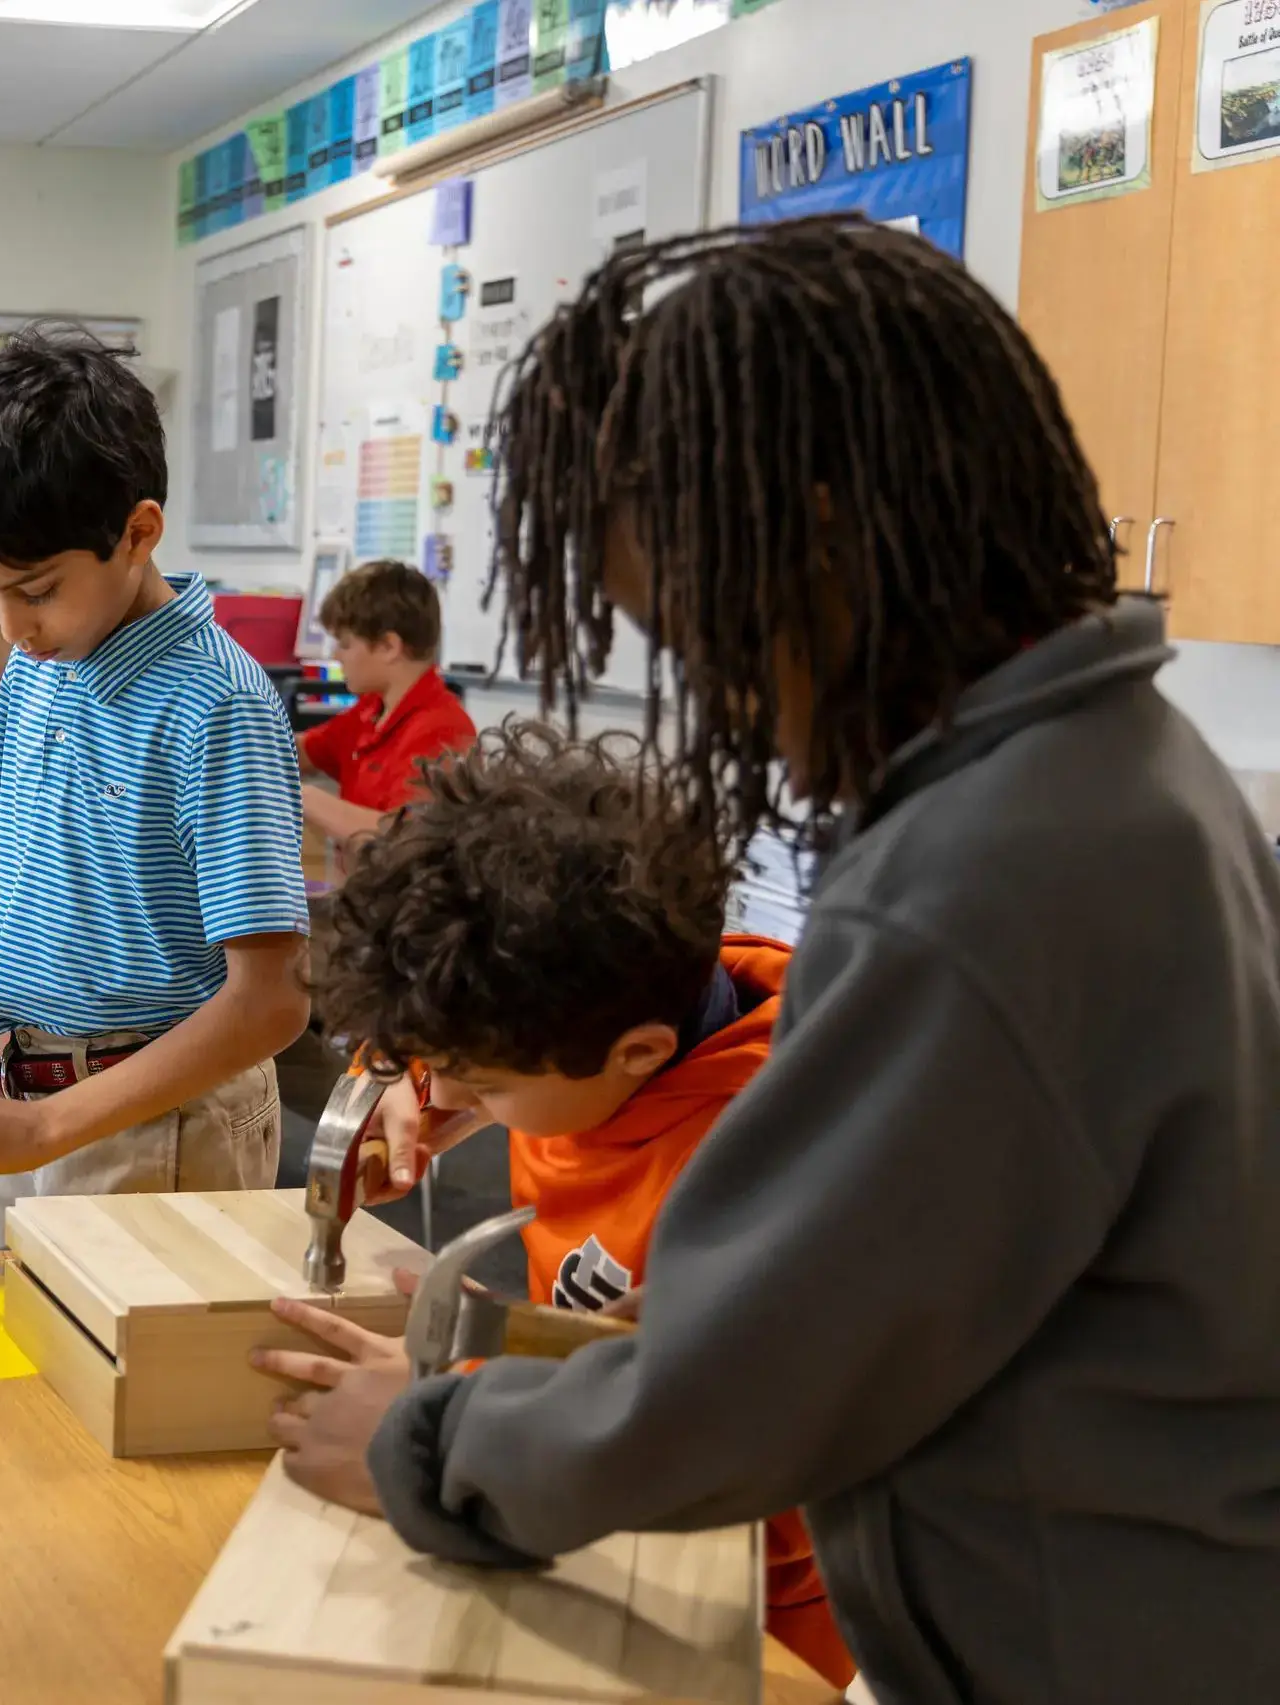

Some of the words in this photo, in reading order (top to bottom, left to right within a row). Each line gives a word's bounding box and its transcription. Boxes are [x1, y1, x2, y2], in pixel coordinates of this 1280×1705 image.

[1244, 0, 1280, 25] 175
[1238, 33, 1258, 49] Battle
[1260, 28, 1268, 44] of
[839, 91, 934, 174] WALL
